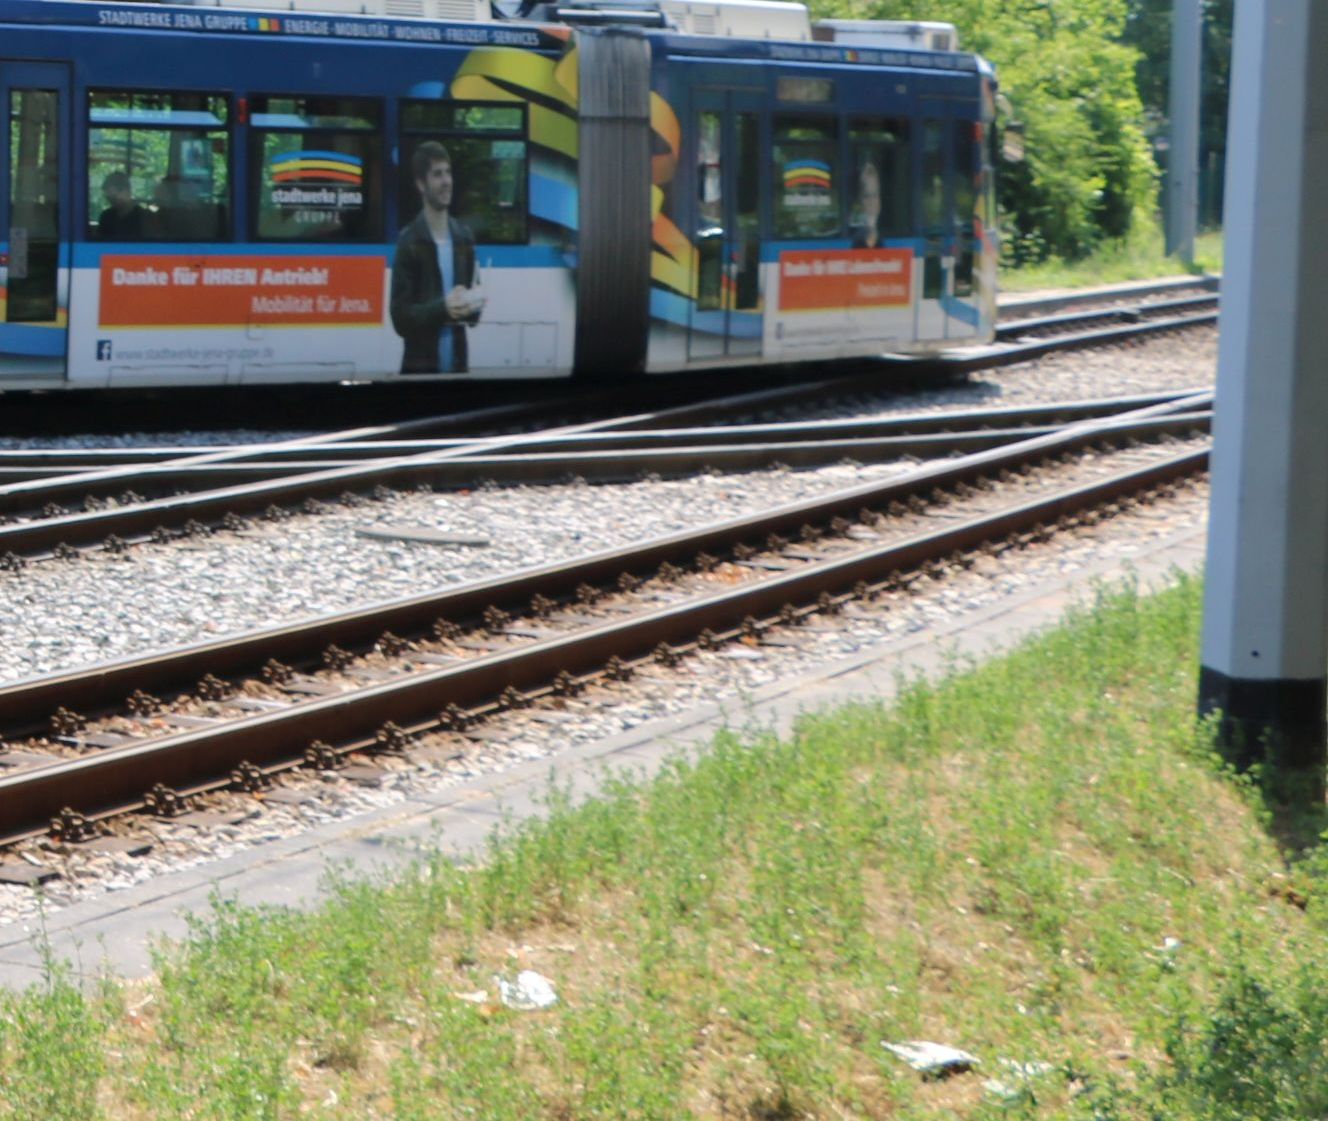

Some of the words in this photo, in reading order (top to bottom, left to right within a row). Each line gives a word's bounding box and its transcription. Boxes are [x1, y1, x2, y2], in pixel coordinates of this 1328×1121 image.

[98, 10, 171, 27] STADTWERKE
[173, 13, 203, 29] JENA
[204, 15, 248, 31] GRUPPE
[284, 18, 330, 36] ENERGIE
[492, 30, 540, 47] SERVICES
[271, 187, 336, 204] stadtwerke
[112, 267, 169, 286] Danke
[172, 266, 200, 286] für
[202, 267, 257, 286] IHREN
[260, 267, 328, 286] Antrieb!
[251, 295, 314, 314] Mobilität
[316, 295, 336, 313] für
[339, 296, 373, 314] Jena.
